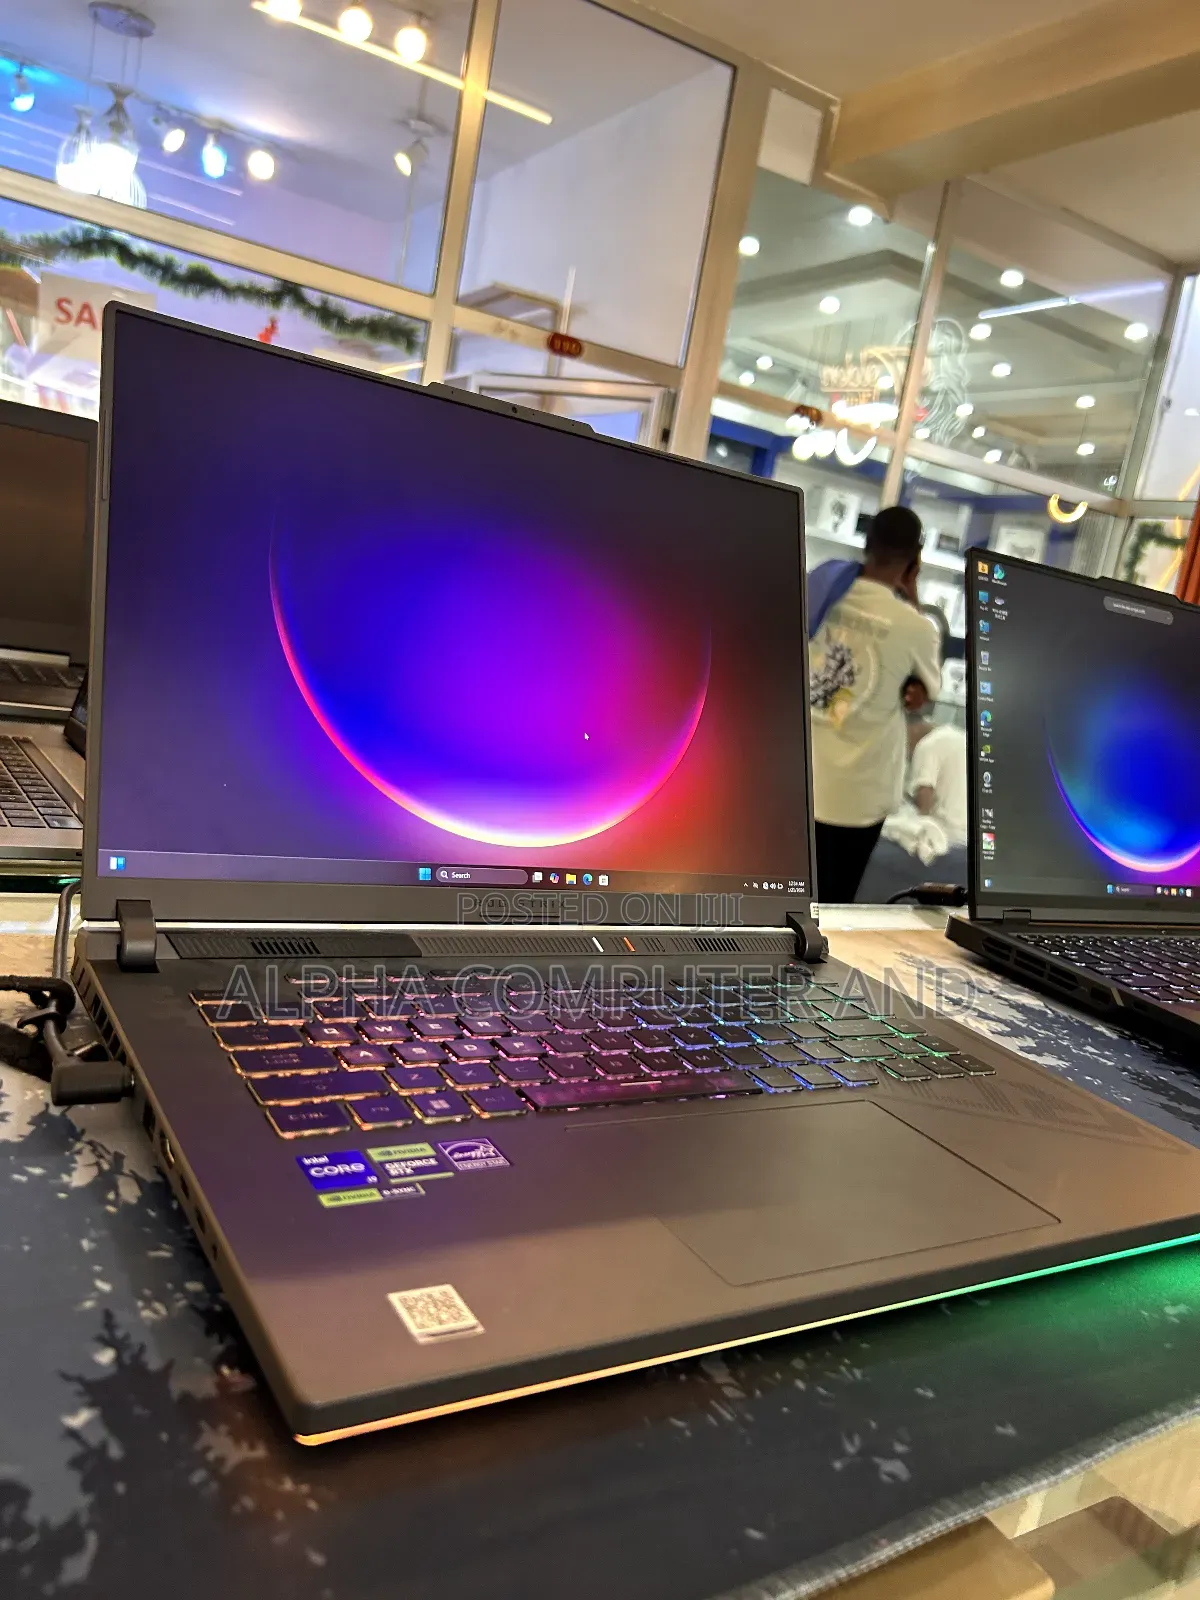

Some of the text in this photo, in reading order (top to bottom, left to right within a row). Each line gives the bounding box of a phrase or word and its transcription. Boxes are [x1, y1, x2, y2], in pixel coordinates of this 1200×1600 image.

[55, 297, 104, 330] SA
[323, 1027, 340, 1035] Q
[375, 1025, 393, 1033] W
[384, 1158, 438, 1170] GEFORCE
[388, 1168, 415, 1177] RTX
